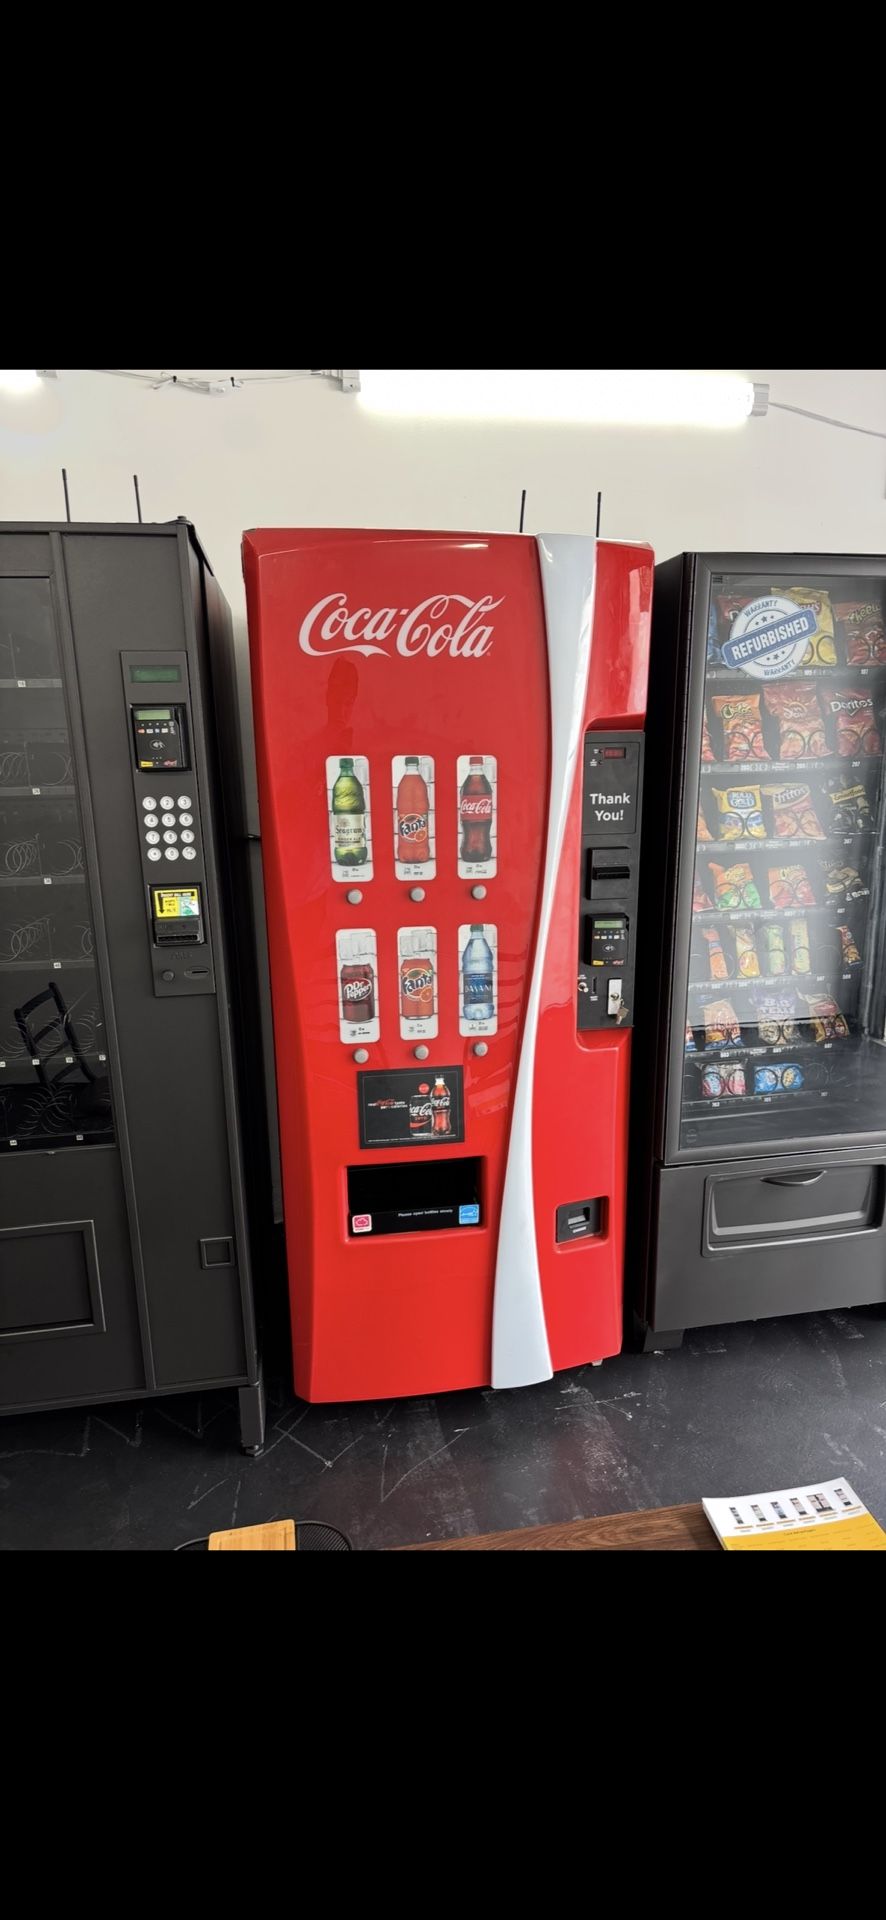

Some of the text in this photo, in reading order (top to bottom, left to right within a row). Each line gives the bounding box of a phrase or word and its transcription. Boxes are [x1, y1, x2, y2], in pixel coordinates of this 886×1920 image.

[743, 600, 778, 617] WARRANTY
[299, 593, 506, 658] Coca-Cola
[731, 617, 809, 661] REFURBISHED
[763, 659, 797, 677] WARRANTY
[830, 699, 874, 713] Doritos
[590, 792, 631, 805] Thank
[594, 809, 625, 822] You!
[346, 983, 370, 999] Pepper
[353, 981, 365, 990] Dr
